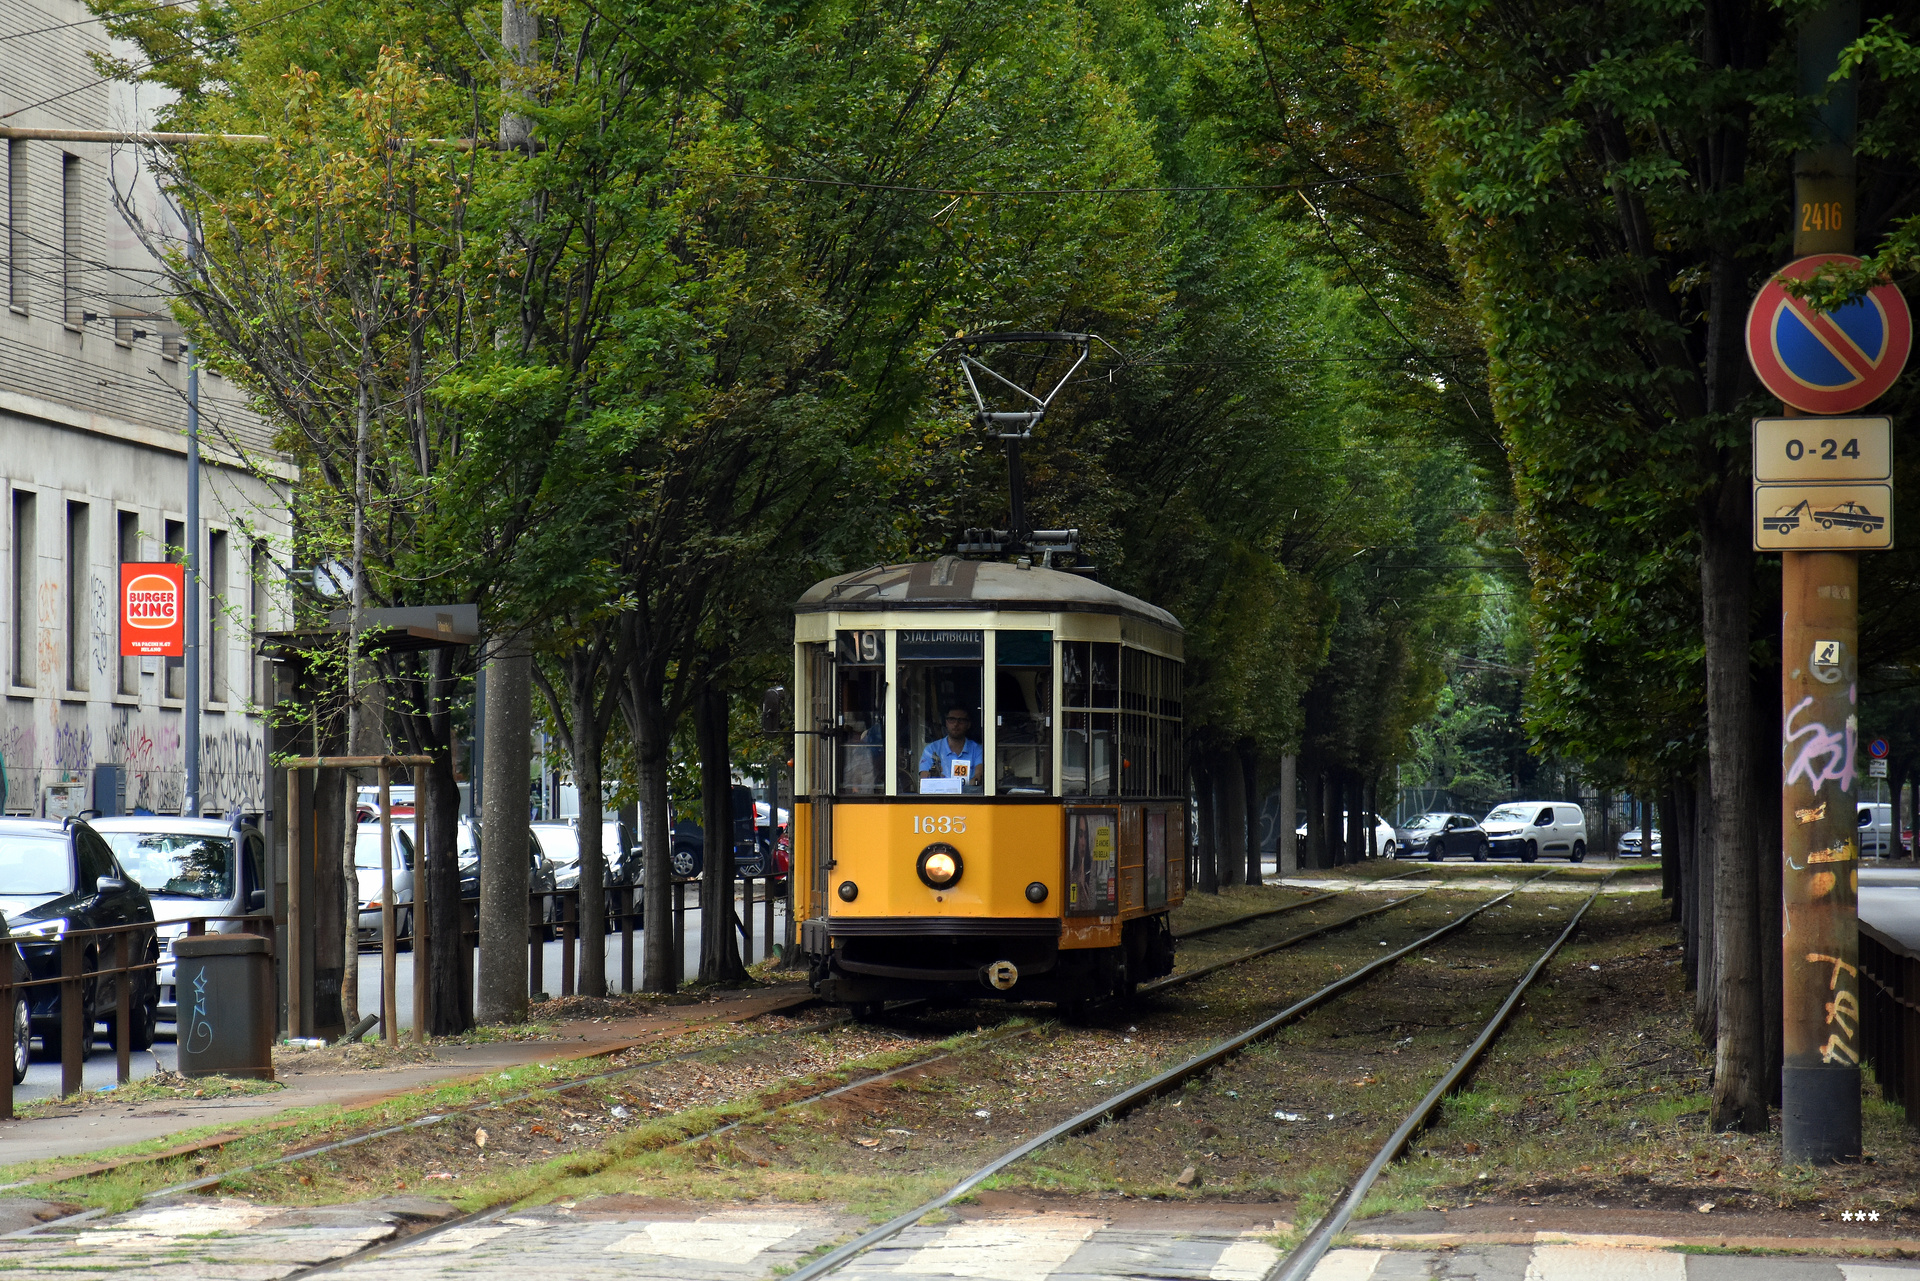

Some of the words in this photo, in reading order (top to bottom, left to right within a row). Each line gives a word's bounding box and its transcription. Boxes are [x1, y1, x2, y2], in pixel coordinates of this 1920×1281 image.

[1801, 202, 1843, 232] 2416
[1785, 438, 1861, 461] 0-24
[129, 592, 174, 602] BURGER
[129, 602, 175, 617] KING
[931, 631, 980, 643] LAMBRATE
[853, 631, 878, 661] 19
[954, 765, 967, 776] 49
[913, 815, 967, 834] 1635
